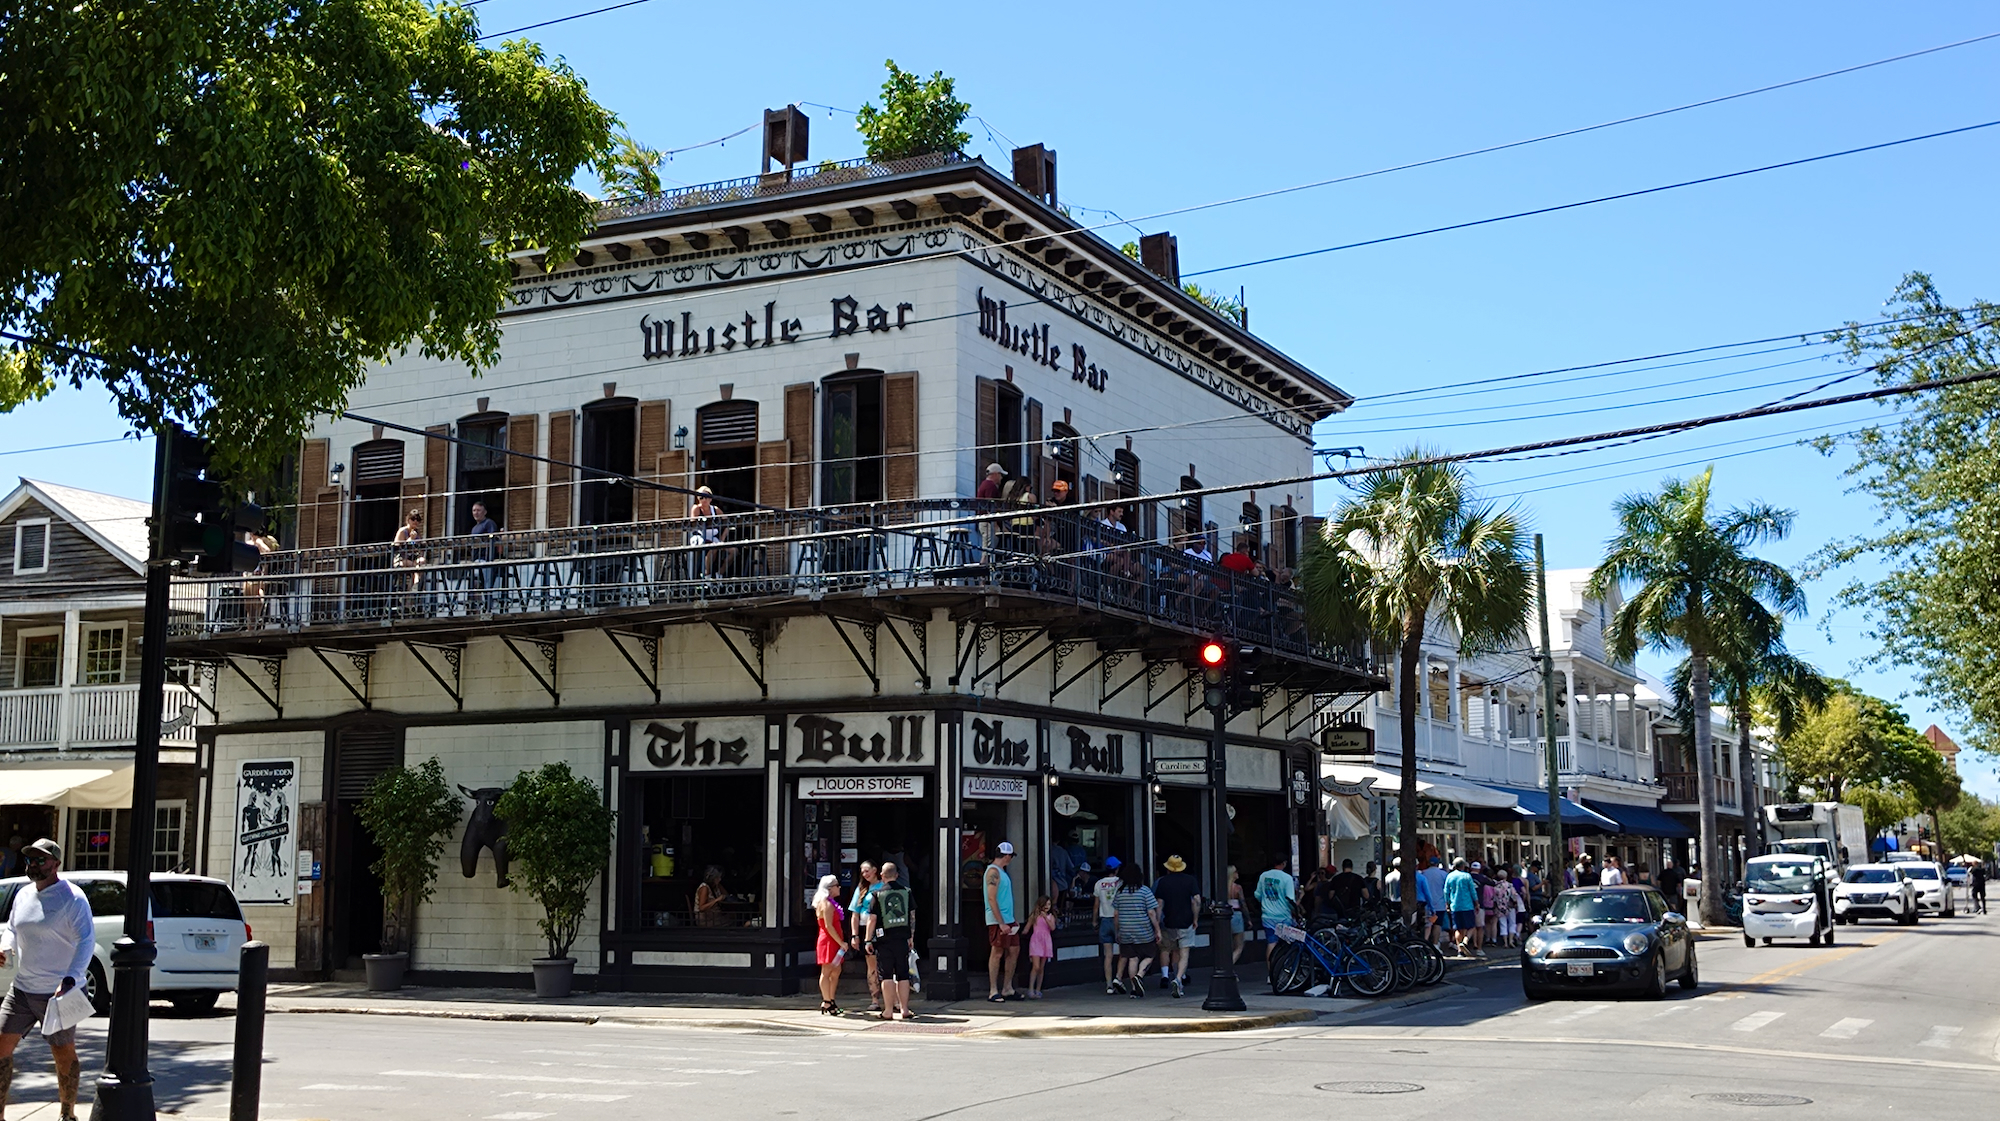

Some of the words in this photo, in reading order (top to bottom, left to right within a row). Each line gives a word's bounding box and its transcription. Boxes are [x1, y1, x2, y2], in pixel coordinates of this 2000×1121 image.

[640, 300, 802, 361] Whistle
[829, 294, 914, 339] Bar
[977, 286, 1061, 371] Whistle
[1071, 342, 1109, 393] Bar
[643, 720, 749, 768] The
[793, 714, 926, 764] Bull
[971, 717, 1031, 767] The
[1066, 725, 1124, 775] Bull
[243, 769, 269, 777] GARDEN
[274, 768, 293, 776] EDEN
[1160, 762, 1192, 770] Caroline
[816, 779, 865, 791] LIQUOR
[867, 778, 912, 790] STORE
[974, 779, 1000, 791] LIQUOR
[1001, 780, 1023, 792] STORE
[1424, 801, 1451, 819] 222
